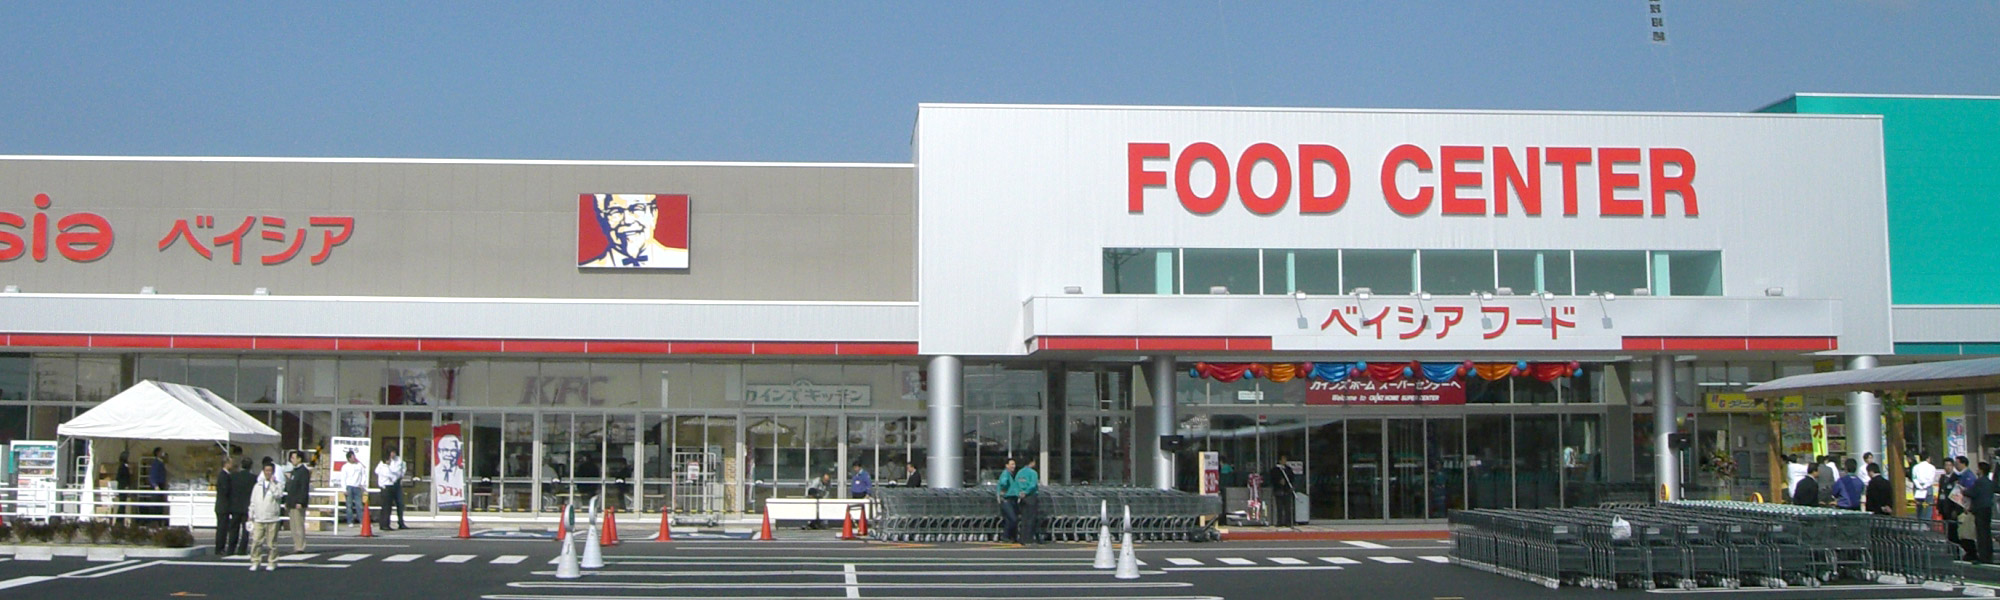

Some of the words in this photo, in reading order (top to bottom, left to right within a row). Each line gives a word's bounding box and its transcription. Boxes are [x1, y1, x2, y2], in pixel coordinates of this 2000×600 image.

[1127, 142, 1351, 215] FOOD
[1380, 144, 1700, 218] CENTER
[157, 215, 355, 265] ベイシア
[1320, 305, 1464, 340] ベイシア
[1480, 305, 1576, 340] フード
[518, 375, 609, 406] KFC
